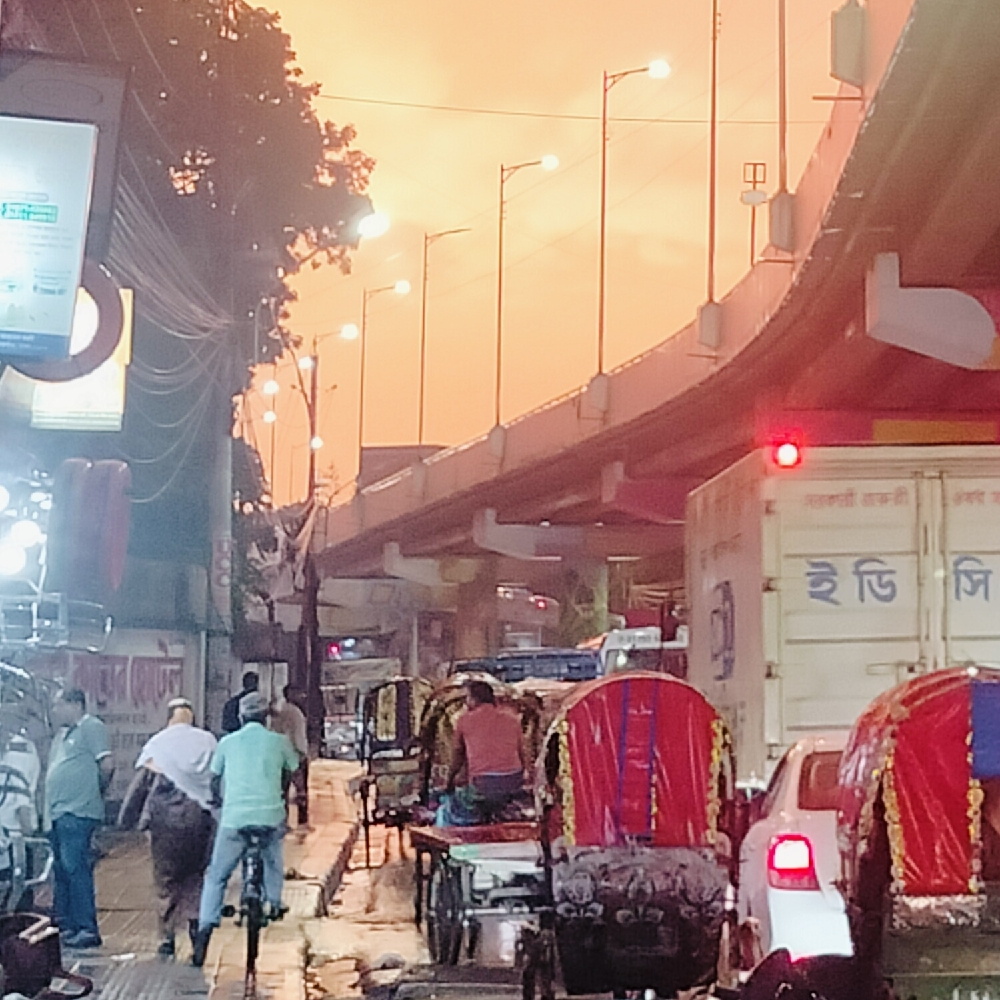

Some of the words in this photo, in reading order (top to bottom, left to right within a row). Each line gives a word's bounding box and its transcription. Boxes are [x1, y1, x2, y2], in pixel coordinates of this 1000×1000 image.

[805, 558, 841, 605] ই
[851, 557, 897, 603] ডি
[952, 556, 993, 602] সি
